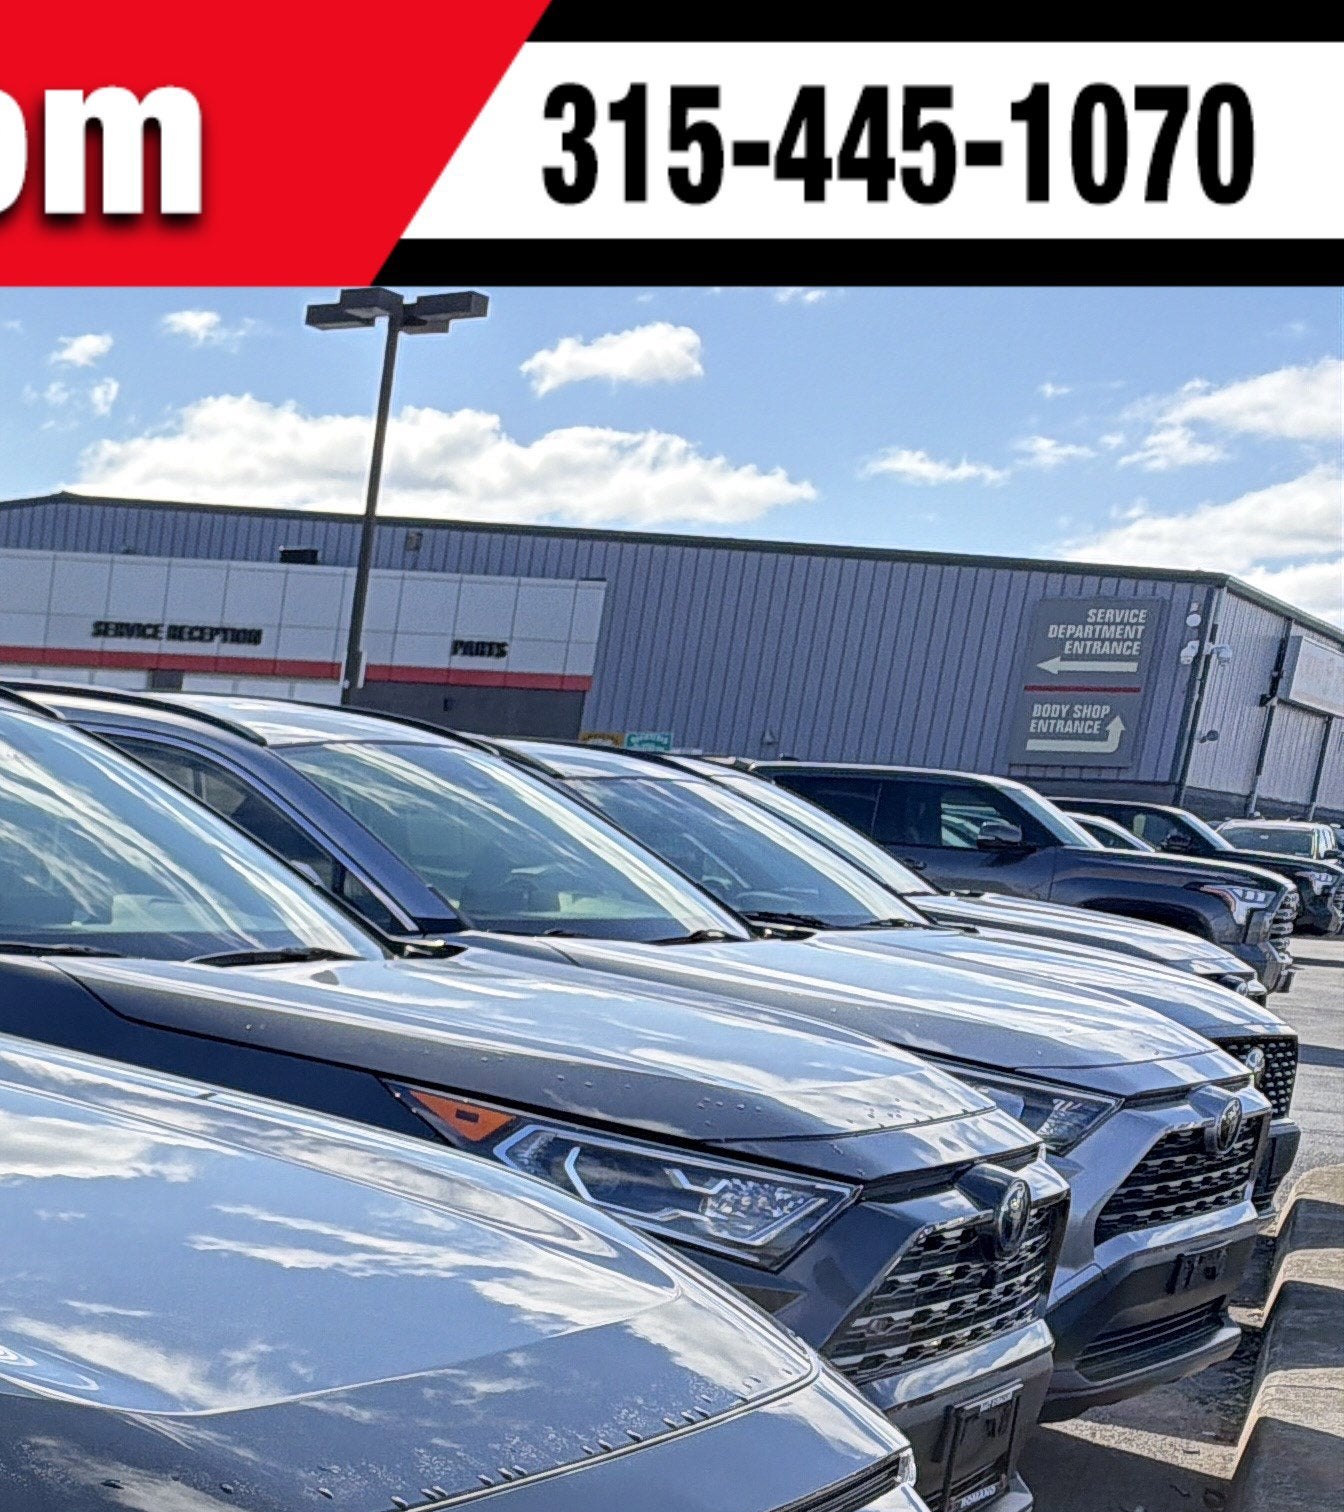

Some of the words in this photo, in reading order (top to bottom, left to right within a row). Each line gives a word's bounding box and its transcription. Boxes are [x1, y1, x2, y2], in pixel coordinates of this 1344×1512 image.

[1086, 608, 1148, 624] SERVICE
[91, 620, 163, 641] SERVICE
[166, 624, 263, 646] RECEPTION
[1047, 623, 1146, 640] DEPARTMENT
[1063, 640, 1142, 656] ENTRANCE
[1031, 703, 1070, 718] BODY
[1072, 704, 1111, 720] SHOP
[1029, 719, 1102, 735] ENTRANCE
